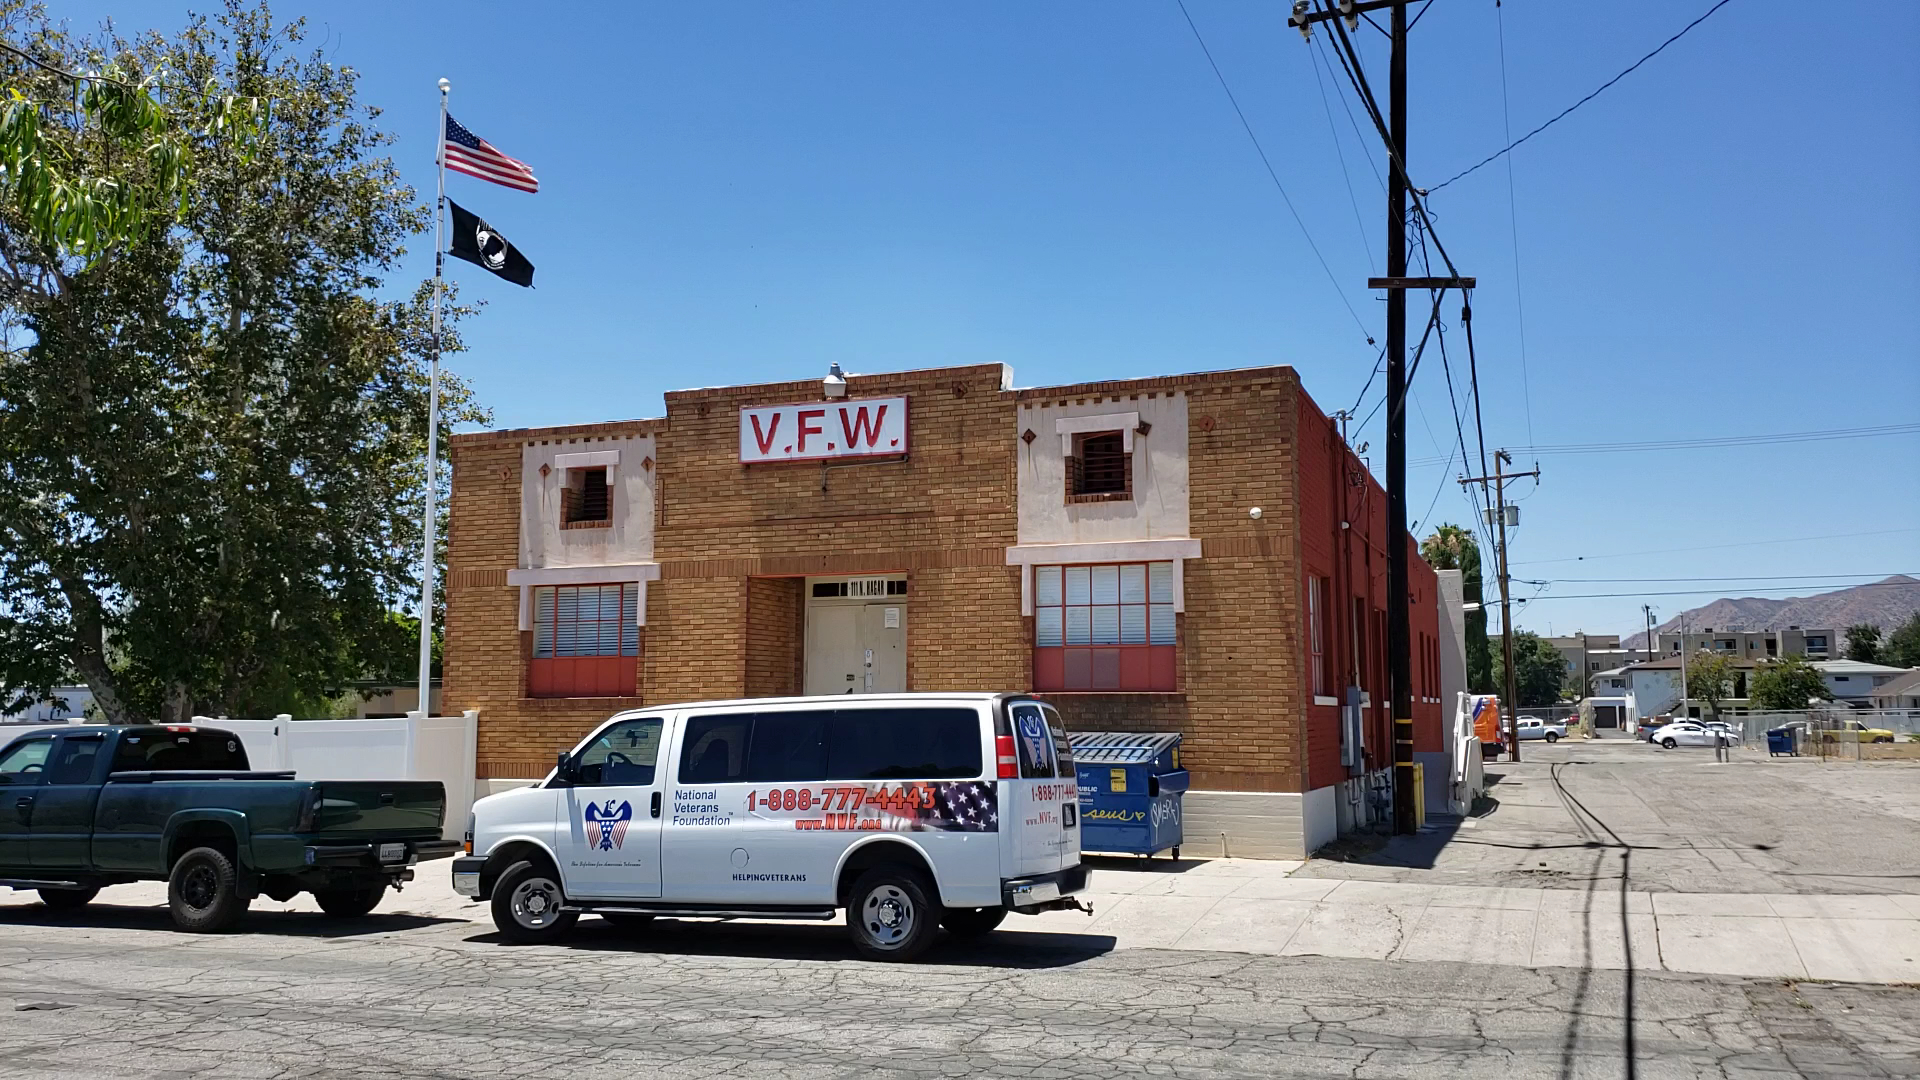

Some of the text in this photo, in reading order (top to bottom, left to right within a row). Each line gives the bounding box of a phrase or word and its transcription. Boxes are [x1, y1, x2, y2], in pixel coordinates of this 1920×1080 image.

[750, 404, 898, 455] V.F.W.
[675, 789, 717, 801] National
[748, 787, 936, 811] 1-888-777-4443
[674, 803, 719, 813] Veterans
[732, 873, 807, 882] HELPINGVETERANS
